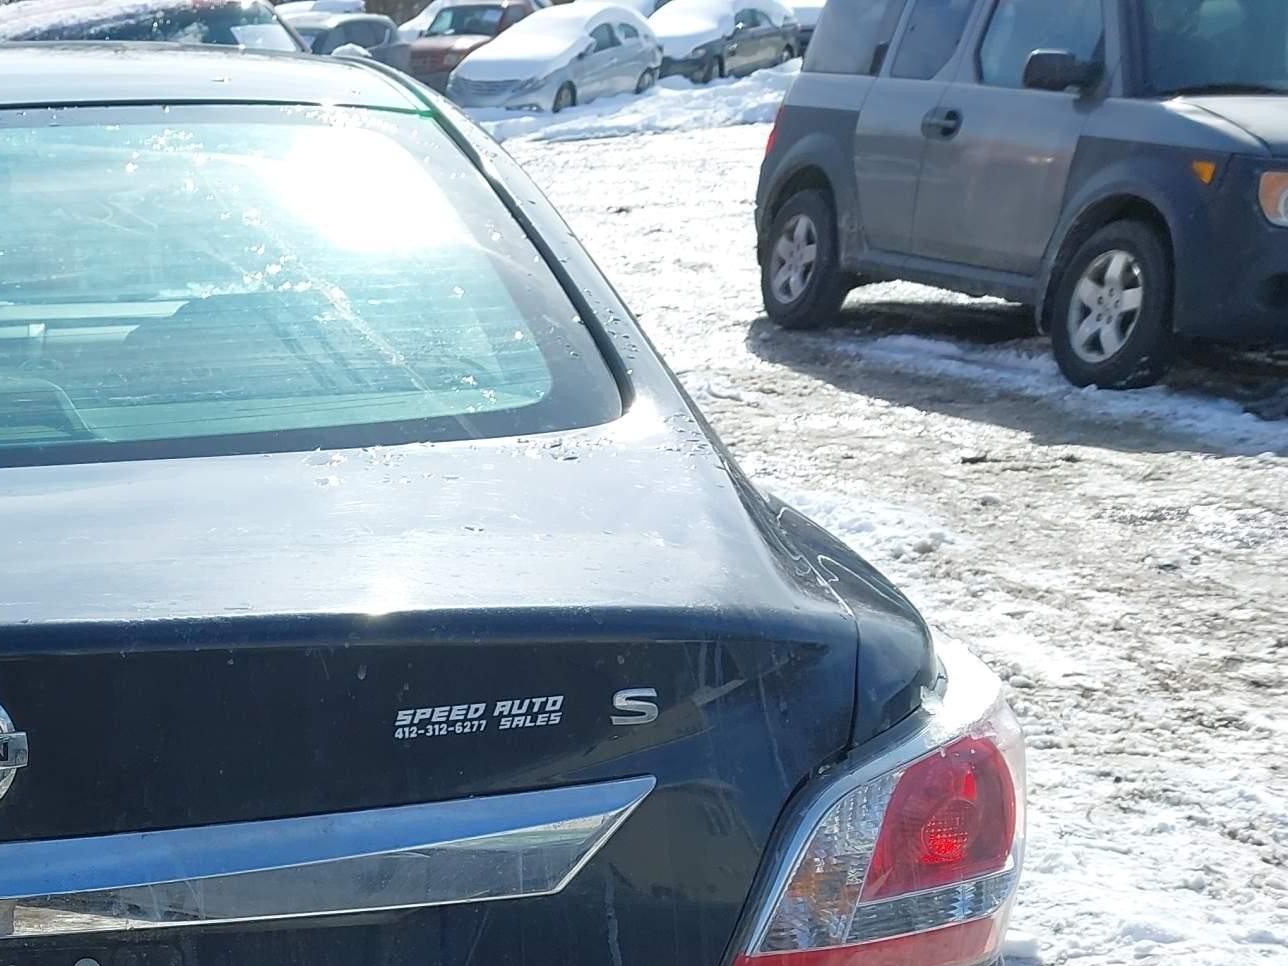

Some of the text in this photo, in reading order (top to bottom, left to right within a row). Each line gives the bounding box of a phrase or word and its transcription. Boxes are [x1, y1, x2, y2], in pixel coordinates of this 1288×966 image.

[394, 695, 564, 726] SPEED AUTO
[610, 687, 659, 726] S
[394, 712, 563, 740] 412-312-6277 SALES
